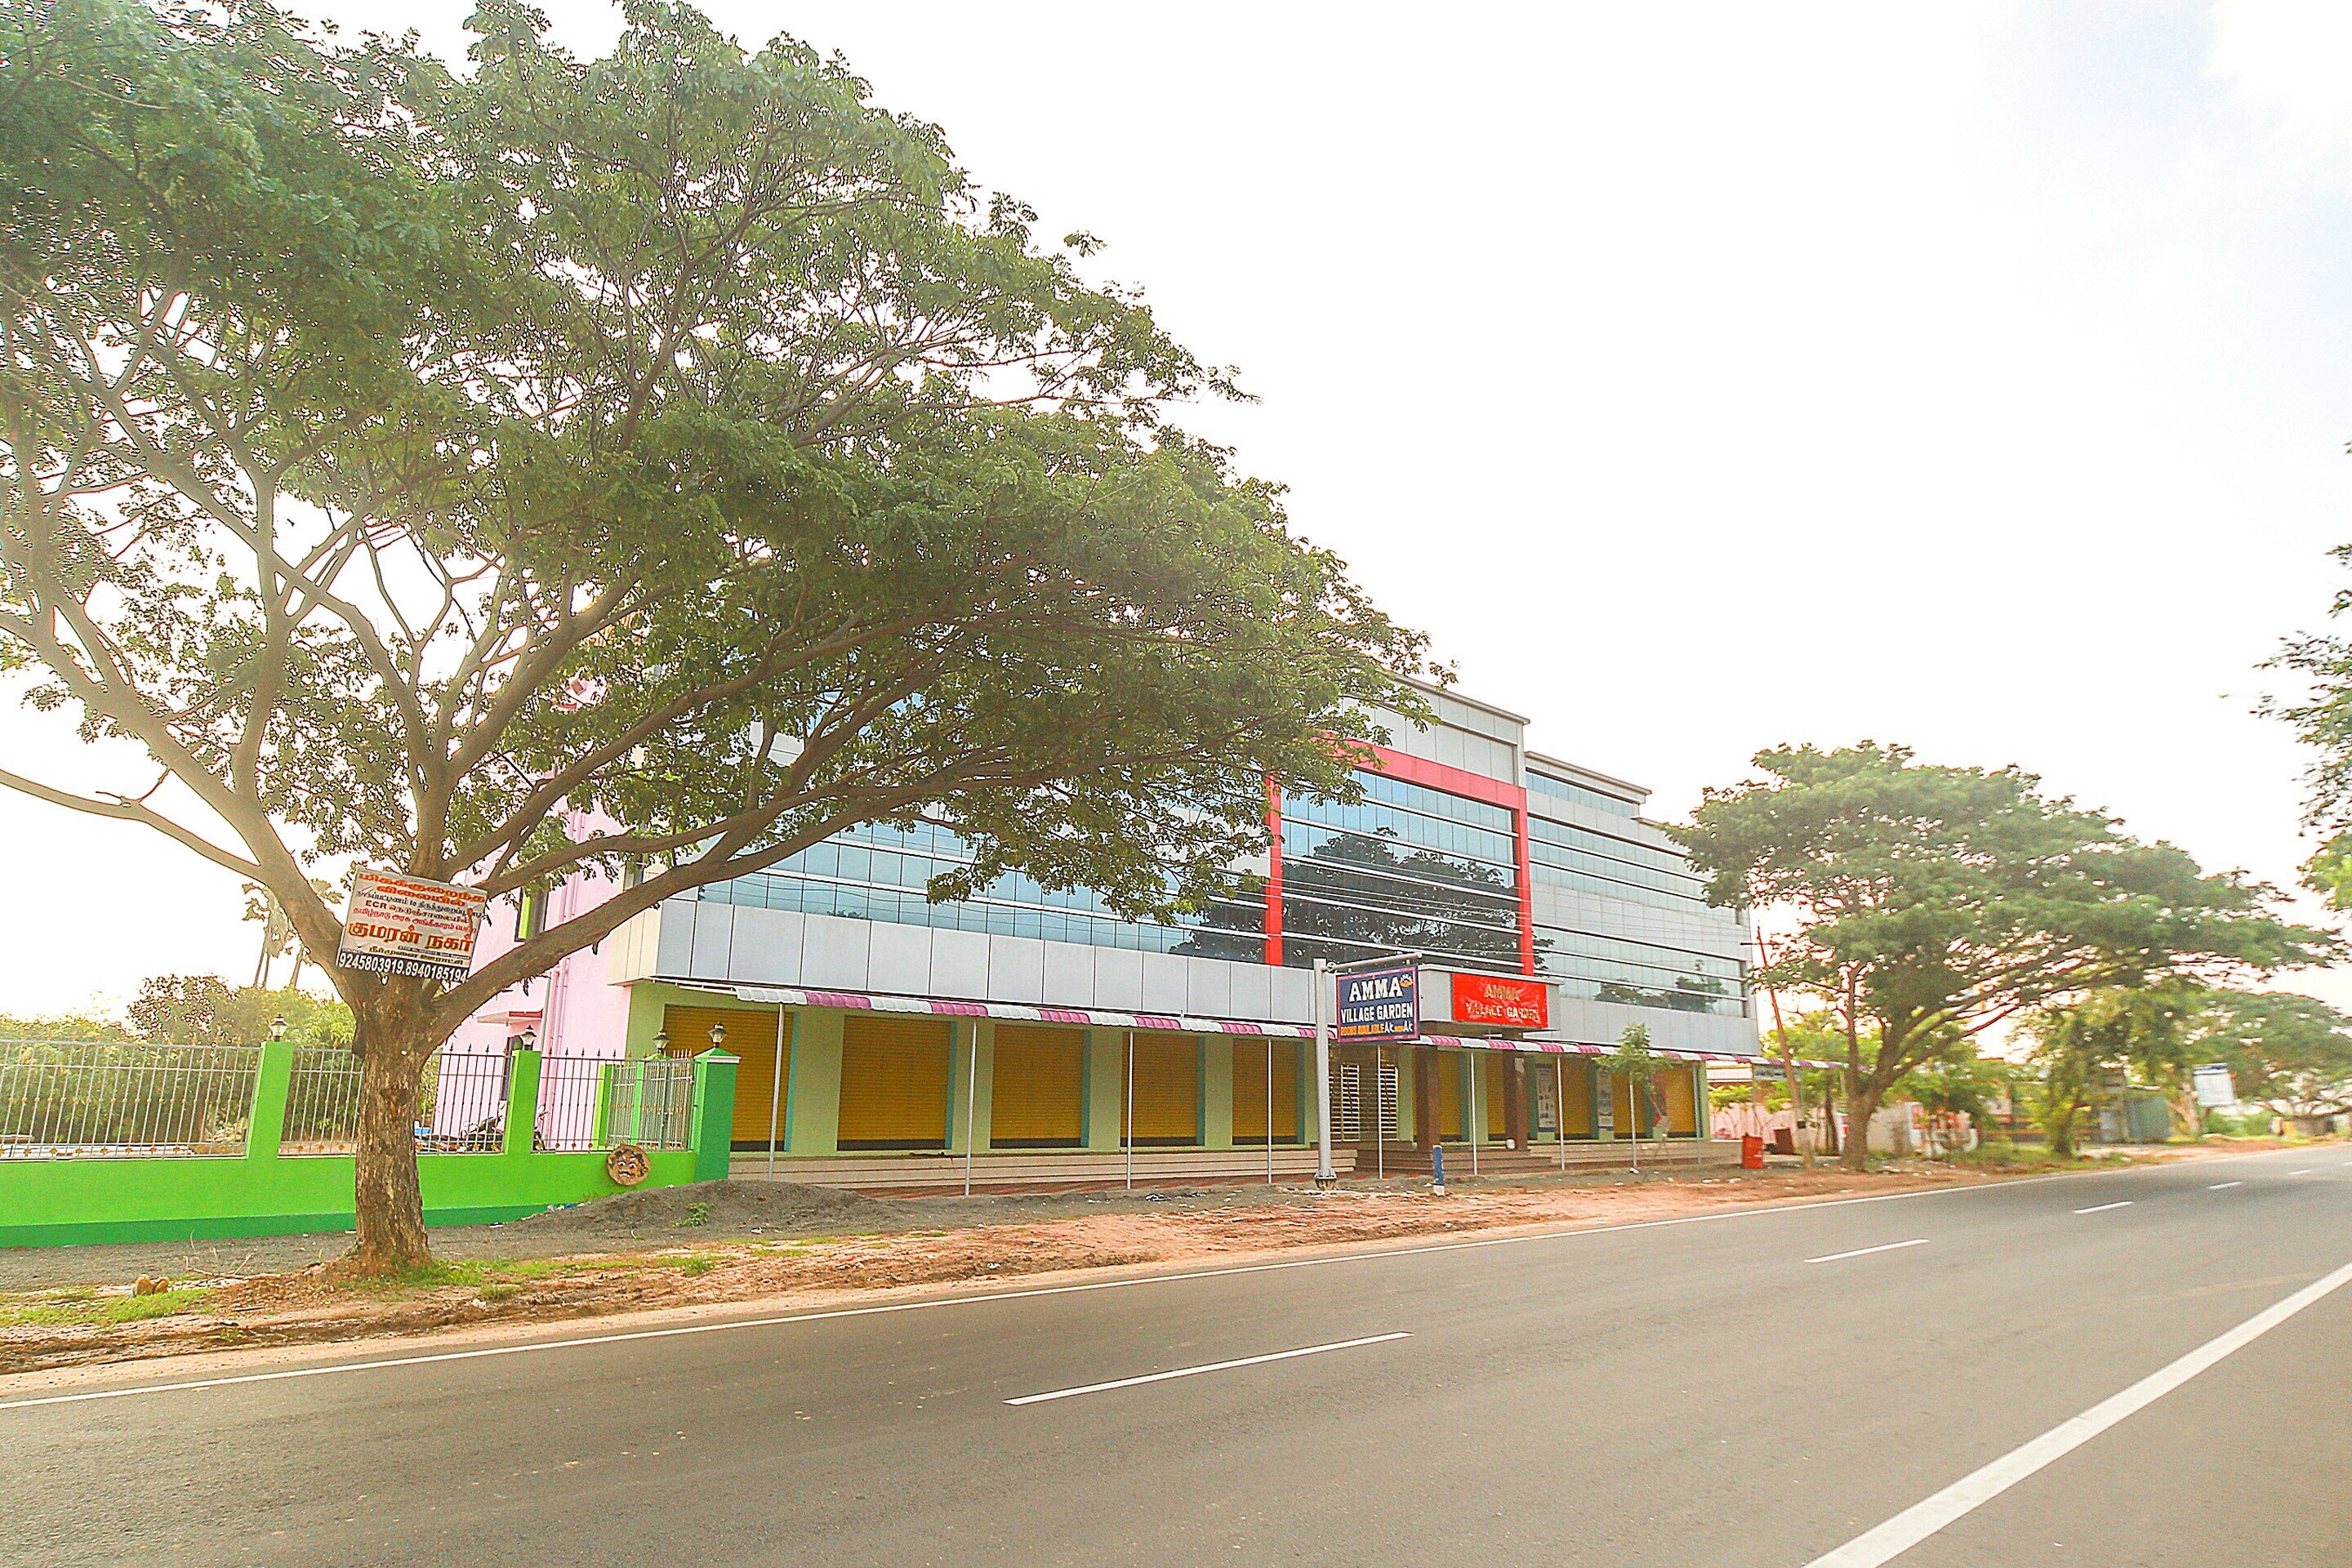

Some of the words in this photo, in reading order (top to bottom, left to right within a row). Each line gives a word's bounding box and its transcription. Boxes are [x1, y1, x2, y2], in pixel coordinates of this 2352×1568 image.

[365, 899, 387, 910] ECR
[376, 885, 466, 906] விலையில்
[348, 924, 423, 944] குமரன்
[425, 933, 474, 952] நகர்
[1348, 976, 1403, 1002] AMMA
[1341, 1005, 1374, 1023] VILLAGE
[1376, 1001, 1413, 1020] GARDEN
